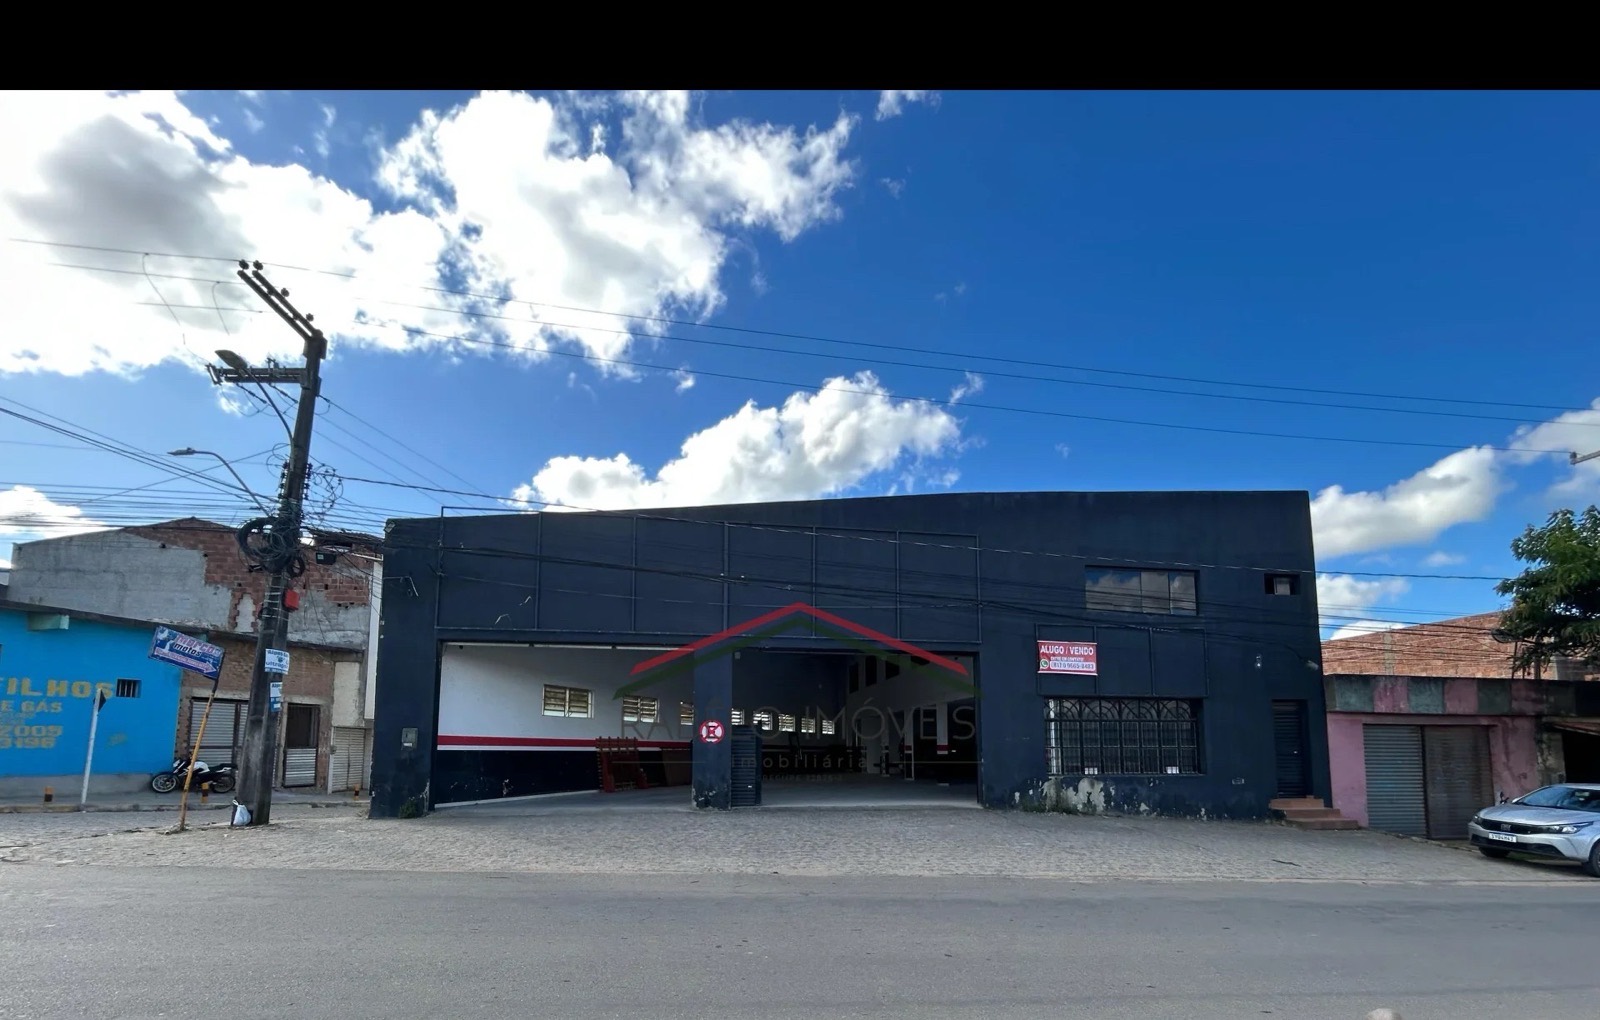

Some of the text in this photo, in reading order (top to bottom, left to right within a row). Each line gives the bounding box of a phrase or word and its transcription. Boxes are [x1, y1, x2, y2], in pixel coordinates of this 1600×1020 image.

[1040, 645, 1064, 654] ALUGO
[1070, 646, 1094, 656] VENDO
[0, 677, 114, 699] ILHOS
